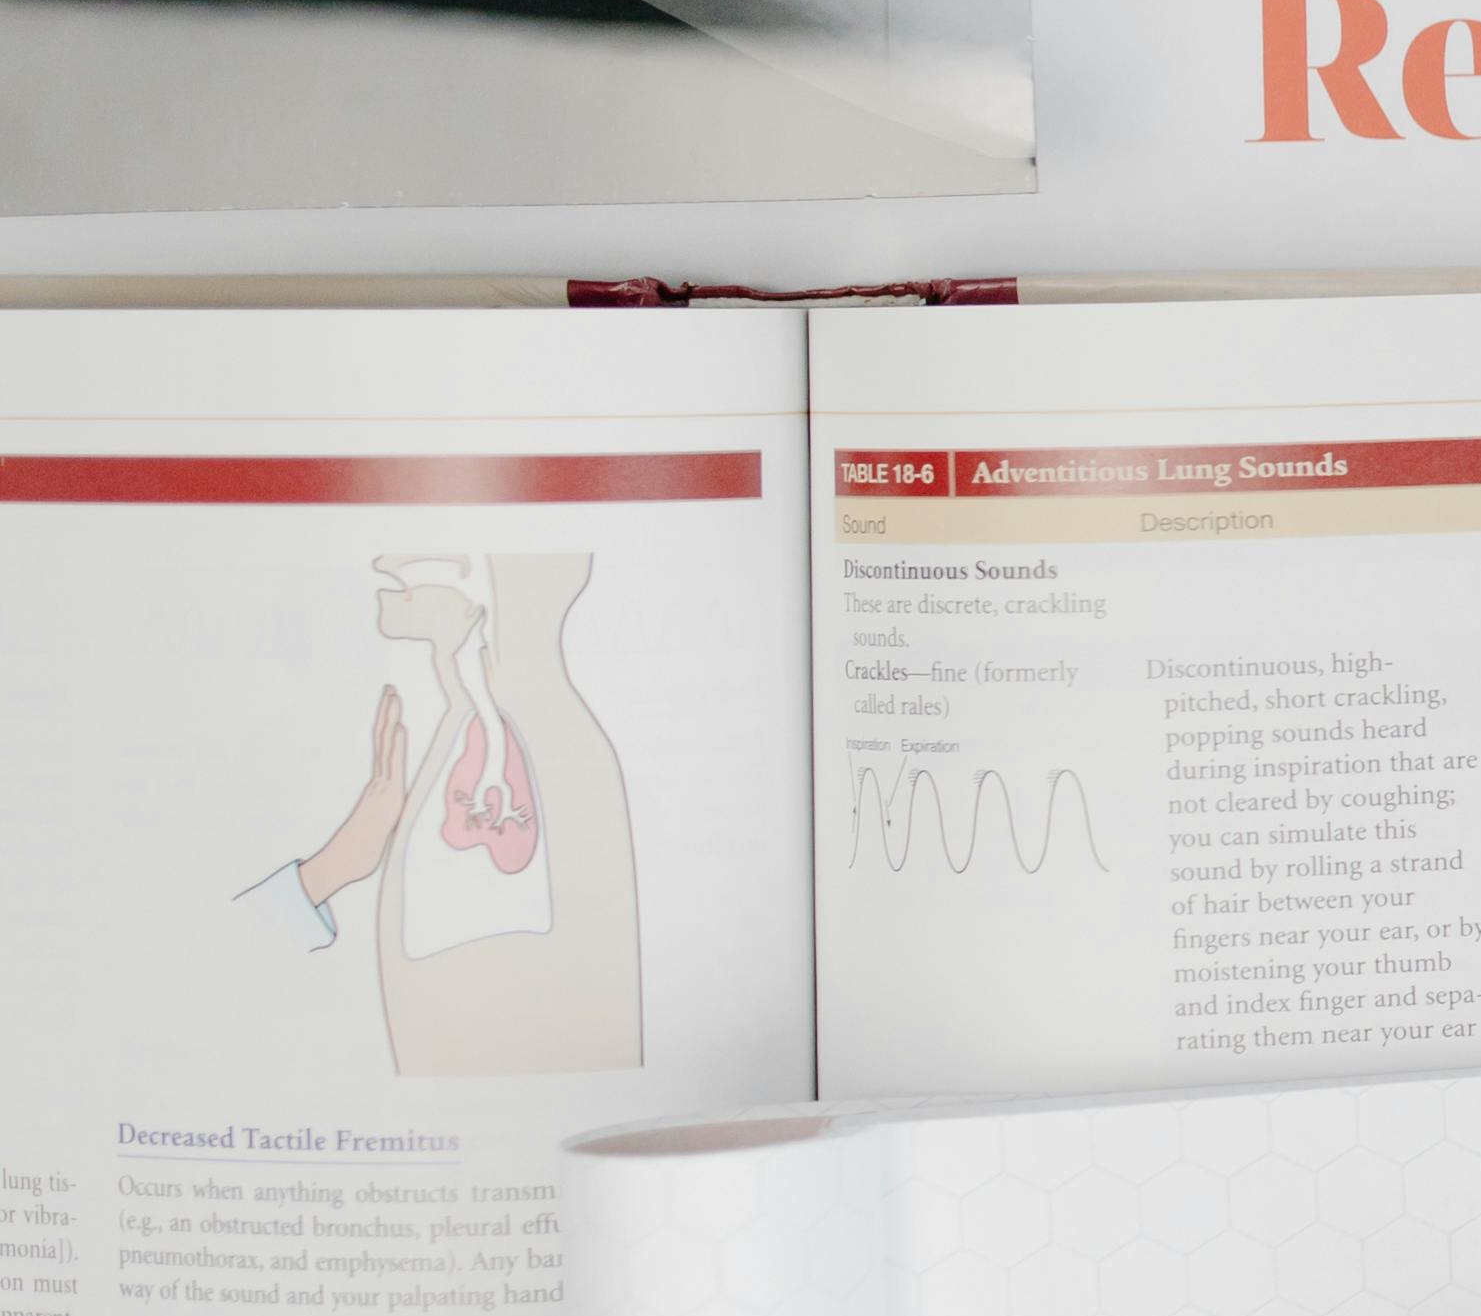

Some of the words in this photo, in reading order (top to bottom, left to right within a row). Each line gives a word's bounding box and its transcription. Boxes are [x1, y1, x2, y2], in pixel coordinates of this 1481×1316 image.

[840, 462, 890, 484] TABLE
[891, 462, 936, 485] 18-6
[971, 460, 1149, 484] Adventitious
[1158, 458, 1232, 487] Lung
[1238, 452, 1349, 479] Sounds
[842, 513, 887, 535] Sound
[1140, 510, 1274, 536] Description
[843, 558, 969, 581] Discontinuous
[974, 558, 1059, 581] Sounds
[842, 591, 883, 614] These
[886, 599, 913, 615] are
[916, 592, 999, 618] discrete,
[1003, 591, 1108, 620] crackling
[852, 625, 911, 649] sounds.
[974, 659, 1080, 688] (formerly
[1146, 655, 1325, 680] Discontinuous,
[1330, 650, 1393, 680] high-
[853, 692, 897, 716] called
[900, 693, 950, 720] rales)
[899, 738, 961, 756] Expiration
[1165, 723, 1265, 754] popping
[1271, 719, 1355, 744] sounds
[1361, 715, 1428, 740] heard
[117, 1122, 236, 1150] Decreased
[240, 1127, 327, 1152] Tactile
[335, 1128, 460, 1152] Fremitus
